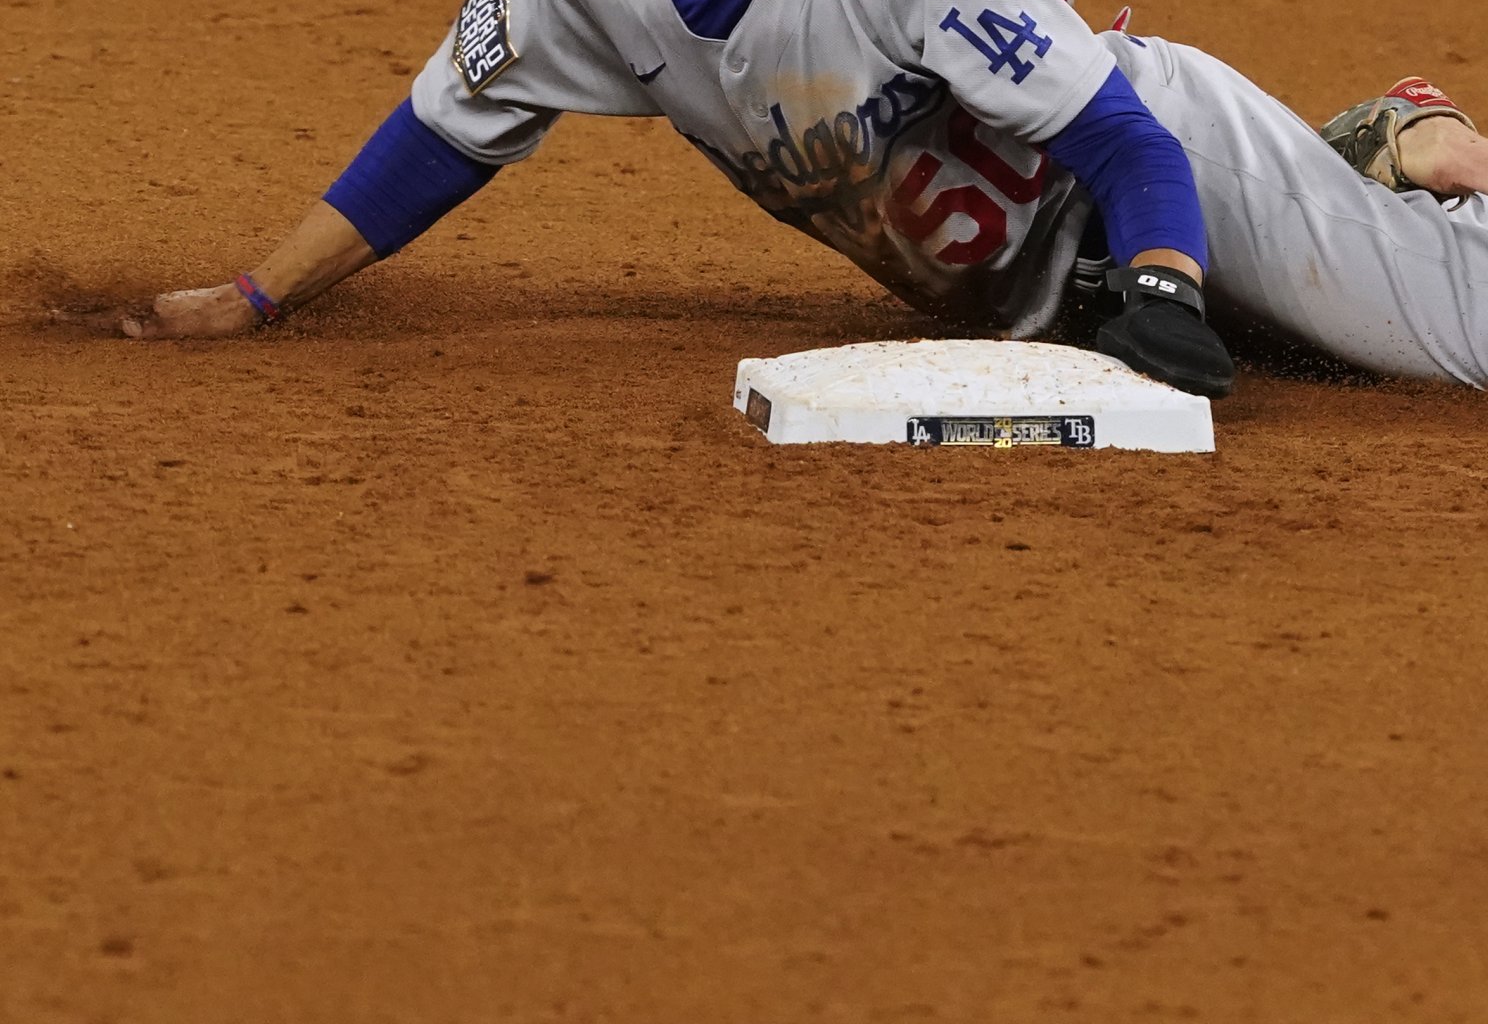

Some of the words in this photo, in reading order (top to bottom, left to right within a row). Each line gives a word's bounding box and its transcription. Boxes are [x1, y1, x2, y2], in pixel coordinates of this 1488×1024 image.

[939, 6, 1053, 85] LA
[680, 72, 946, 212] odgers
[907, 418, 931, 446] LA
[941, 424, 994, 443] WORLD
[1012, 423, 1062, 443] SERIES
[1064, 418, 1092, 445] TB
[994, 438, 1012, 449] 20
